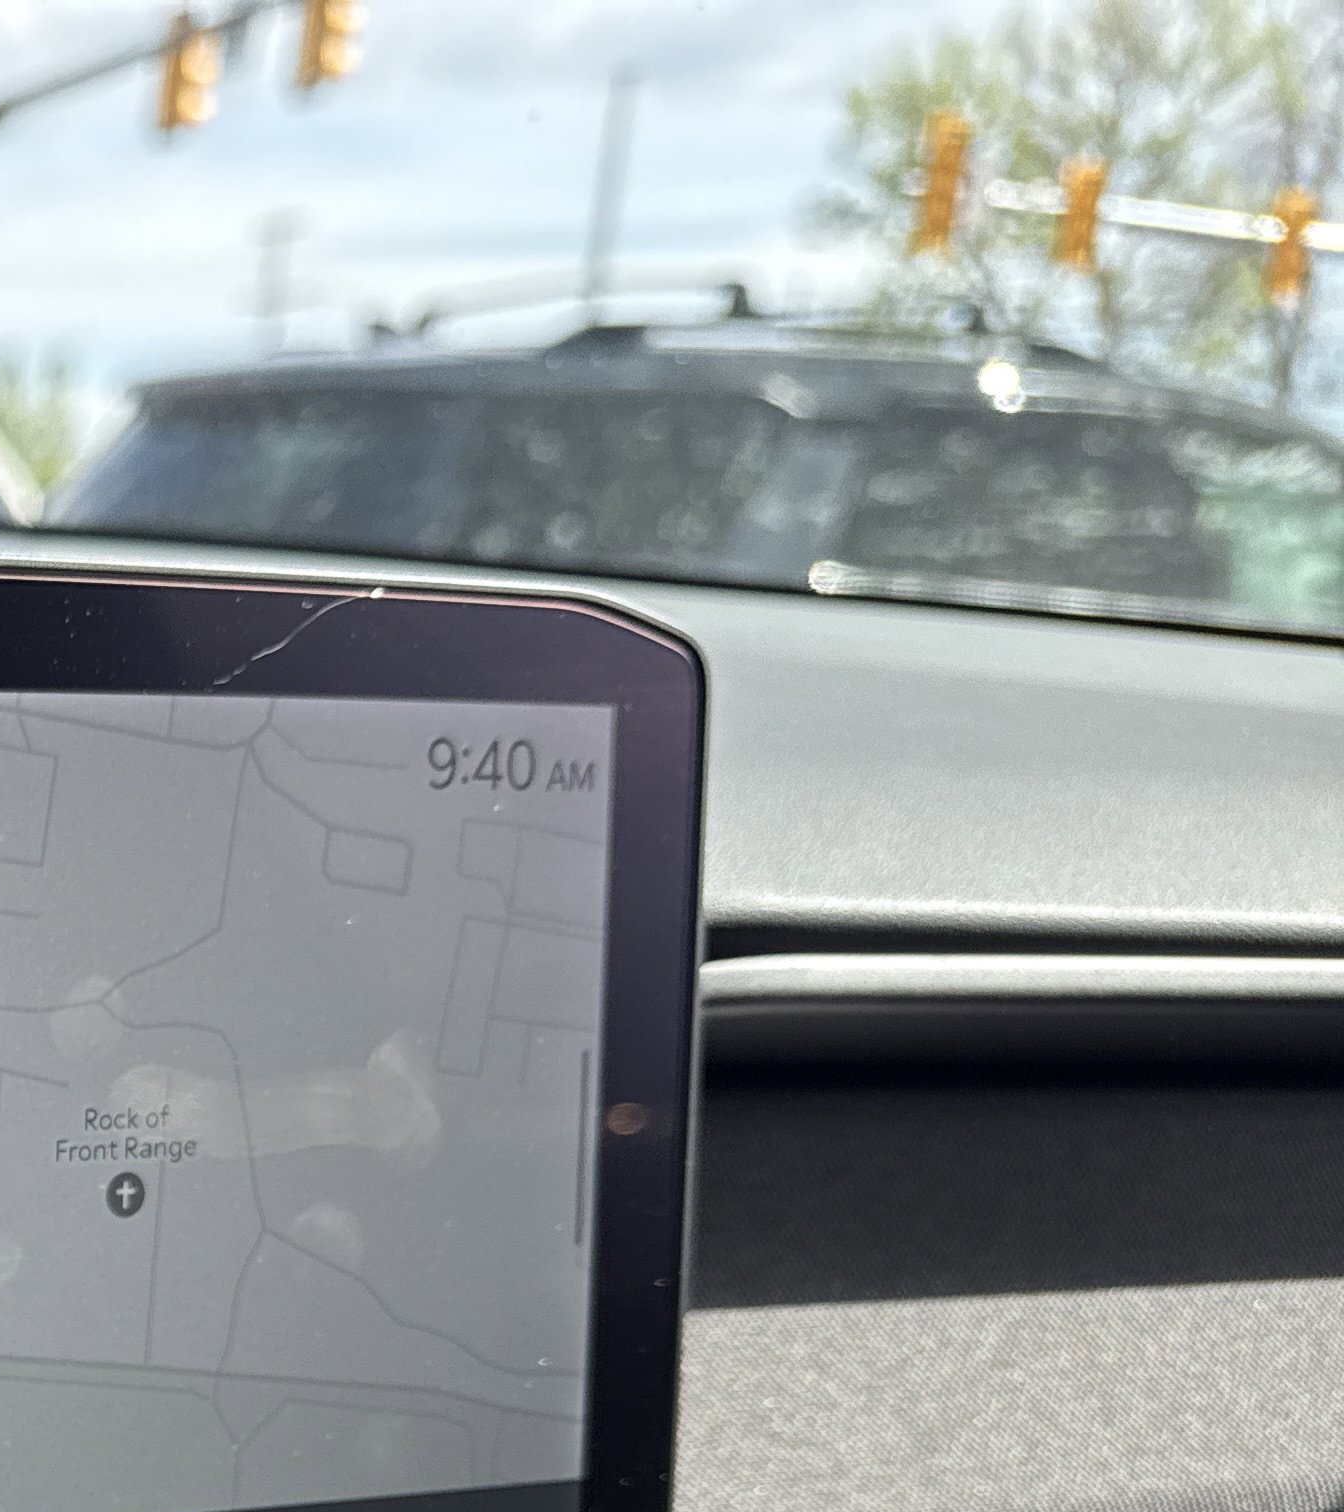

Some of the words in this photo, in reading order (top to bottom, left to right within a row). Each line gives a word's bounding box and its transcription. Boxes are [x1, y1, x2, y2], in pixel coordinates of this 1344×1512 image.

[428, 737, 536, 791] 9:40
[545, 760, 596, 792] AM
[84, 1107, 139, 1131] Rock
[145, 1104, 169, 1129] of
[55, 1139, 118, 1162] Front
[124, 1137, 197, 1163] Range
